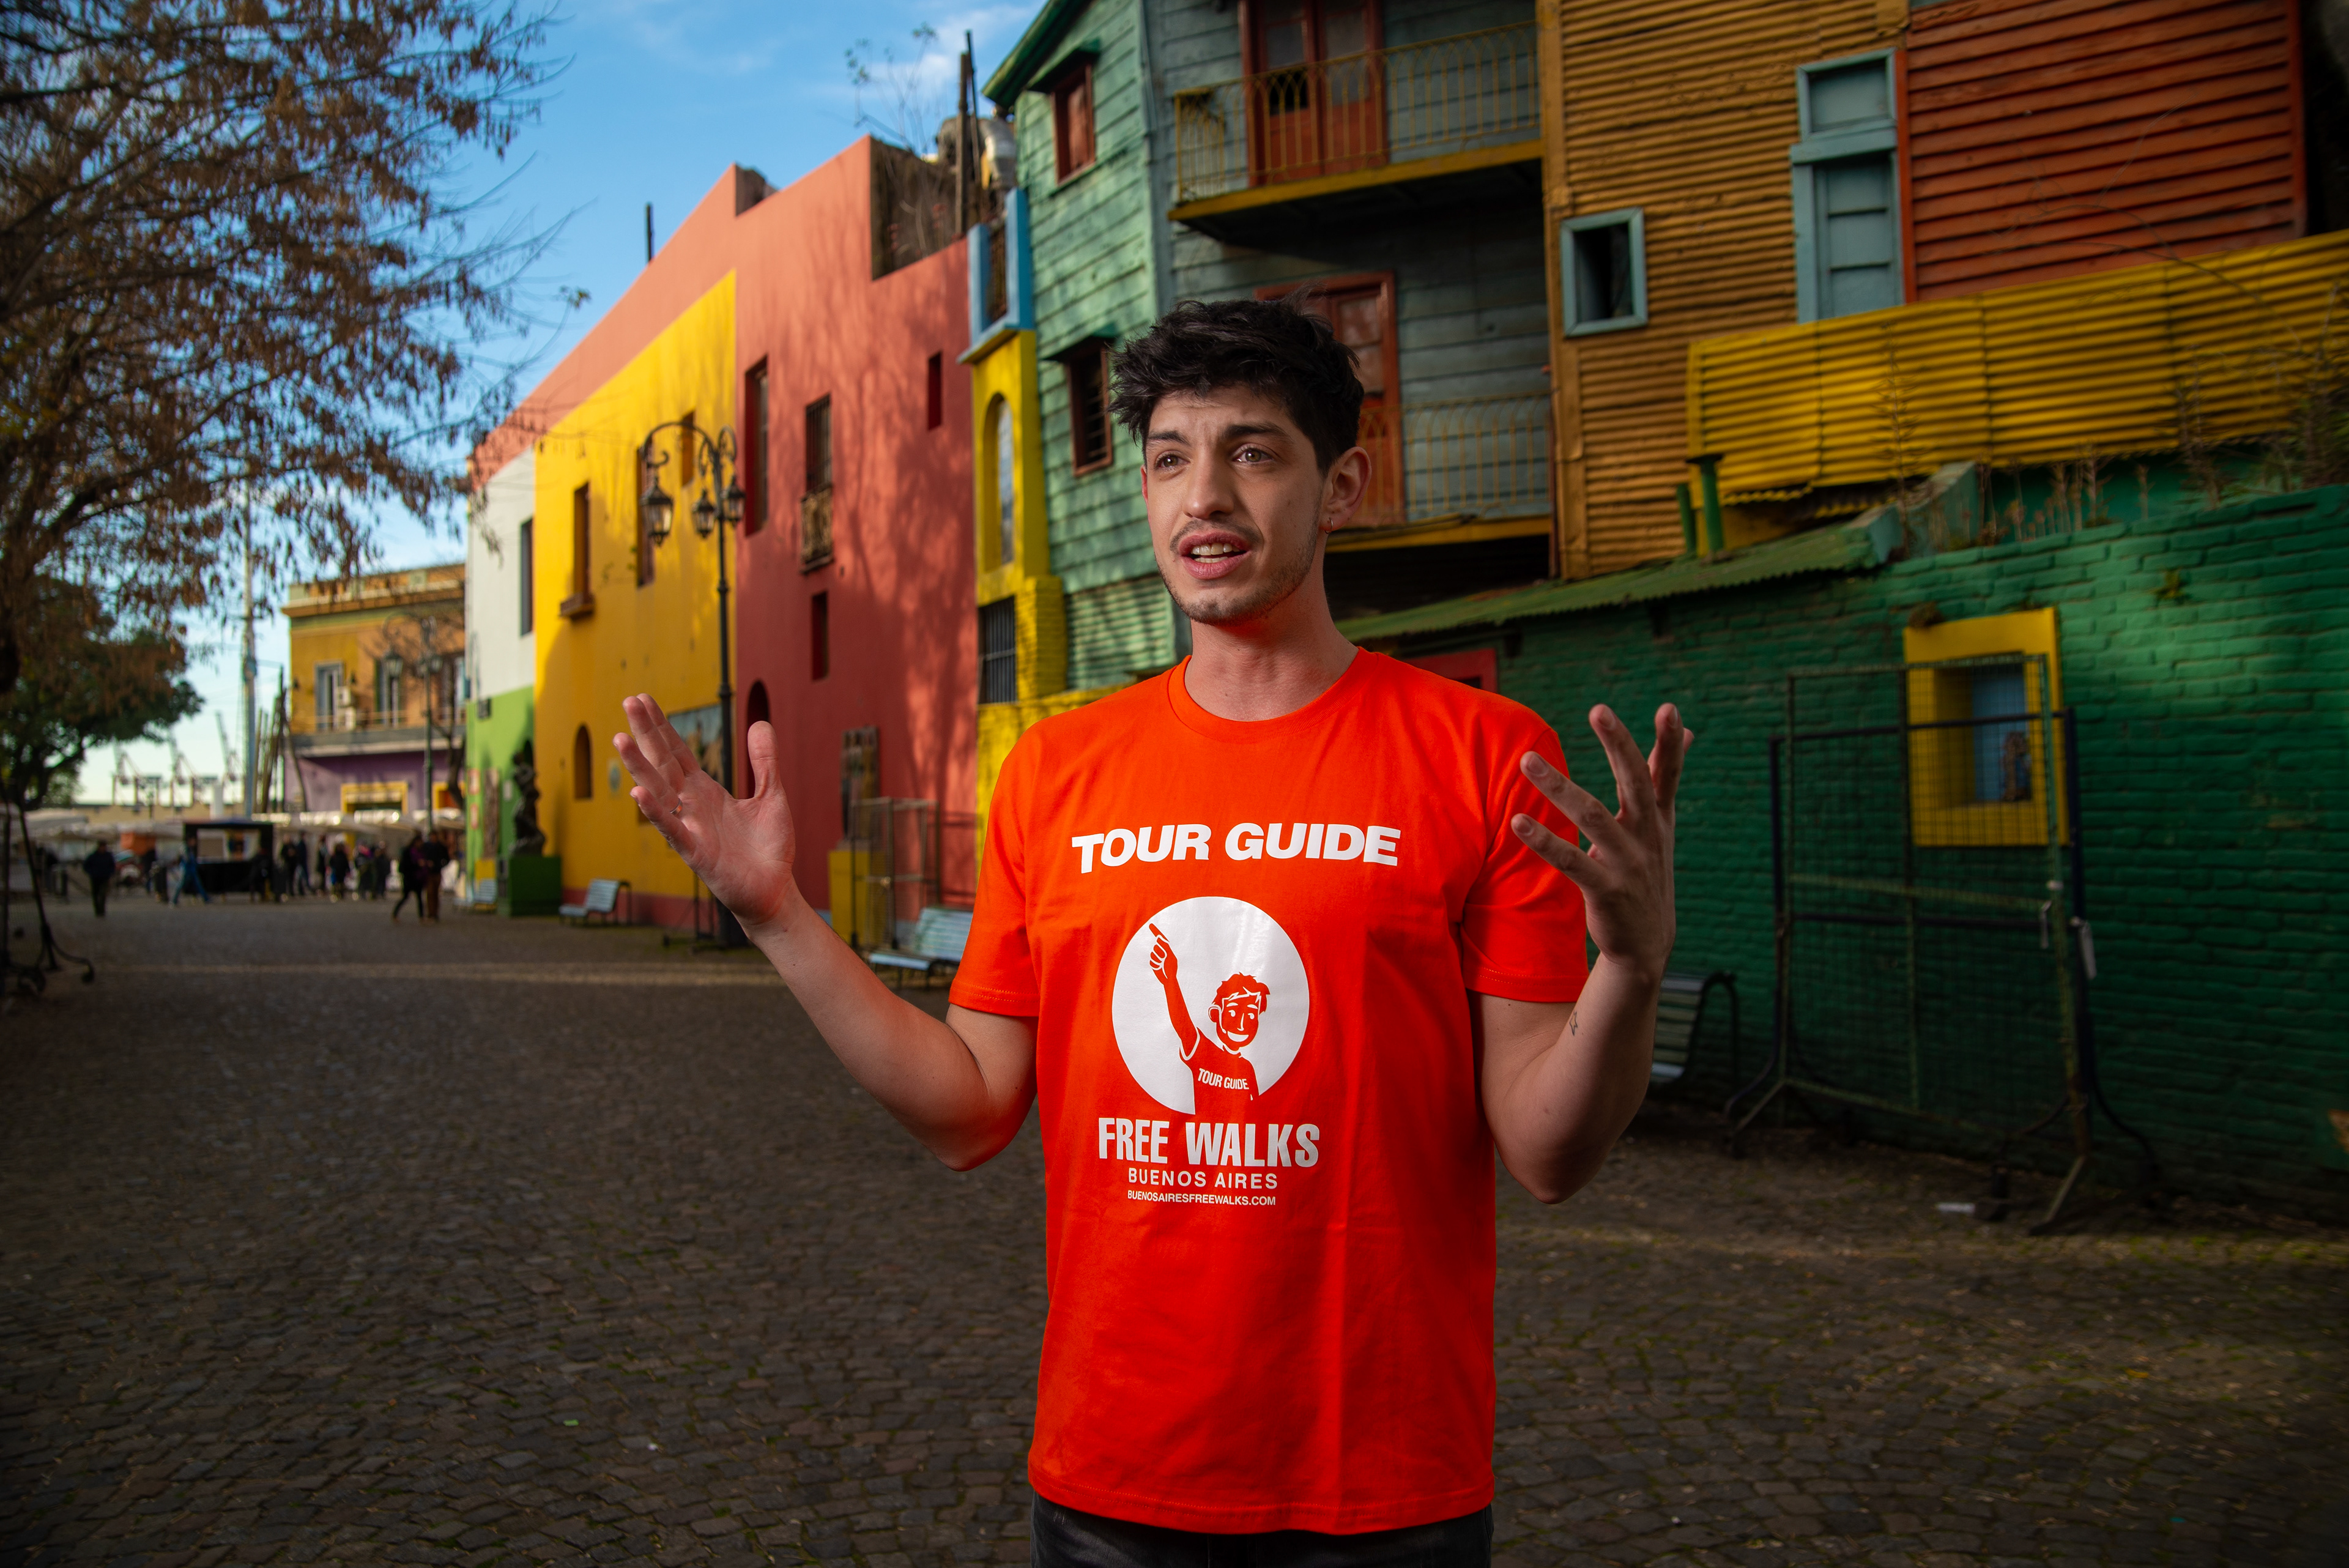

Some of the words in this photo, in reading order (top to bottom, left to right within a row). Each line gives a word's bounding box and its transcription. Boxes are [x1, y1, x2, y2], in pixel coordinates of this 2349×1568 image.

[1072, 823, 1212, 874] TOUR
[1225, 822, 1401, 866] GUIDE
[1198, 1068, 1223, 1088] TOUR
[1223, 1077, 1250, 1090] GUIDE
[1098, 1117, 1170, 1164] FREE
[1185, 1122, 1320, 1167] WALKS
[1128, 1167, 1206, 1187] BUENOS
[1214, 1172, 1277, 1189] AIRES
[1127, 1190, 1276, 1206] BUENOSAIRESFREEWALKS.COM
